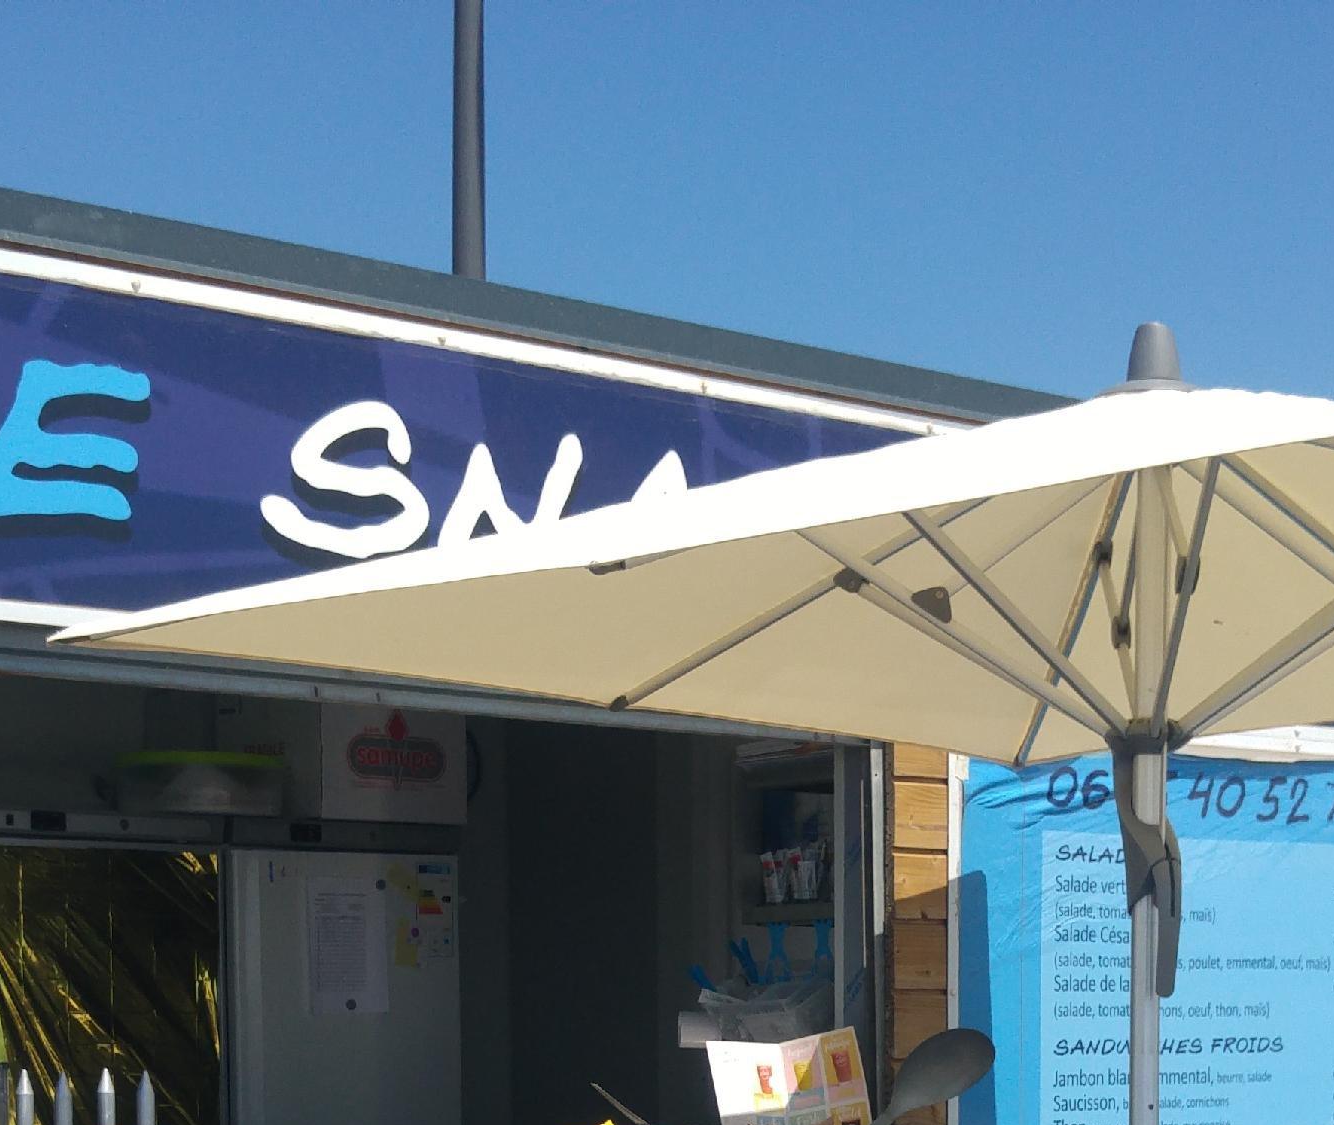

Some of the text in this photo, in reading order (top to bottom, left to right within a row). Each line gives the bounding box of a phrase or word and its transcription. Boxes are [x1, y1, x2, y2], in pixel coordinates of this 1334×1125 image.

[1046, 766, 1110, 810] 06
[1187, 772, 1246, 819] 40
[1256, 775, 1310, 825] 52
[1055, 875, 1097, 894] Salade
[1054, 924, 1130, 945] Salade Césa
[1054, 974, 1096, 993] Salade
[1100, 974, 1116, 993] de
[1211, 1037, 1284, 1054] FROIDS
[1053, 1068, 1104, 1088] Jambon
[1053, 1095, 1120, 1114] Saucisson,
